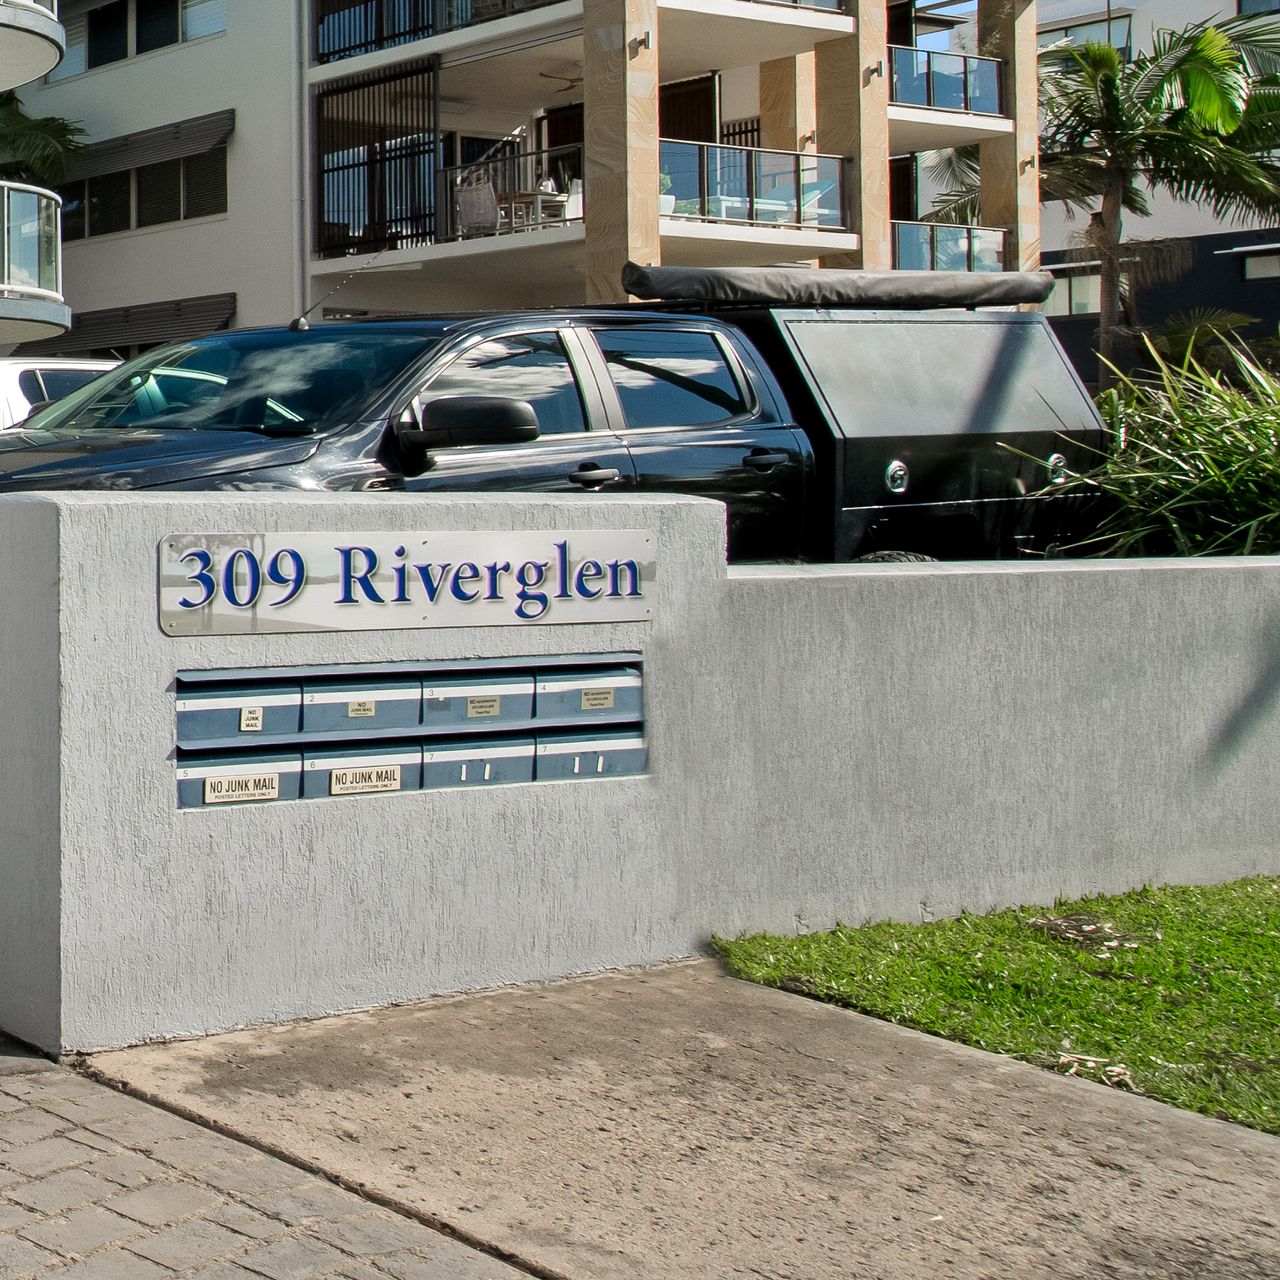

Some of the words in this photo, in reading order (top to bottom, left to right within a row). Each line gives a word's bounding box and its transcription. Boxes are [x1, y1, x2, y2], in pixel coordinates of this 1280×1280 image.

[177, 547, 306, 609] 309
[333, 539, 643, 619] Riverglen
[209, 780, 223, 794] NO
[225, 779, 250, 793] JUNK
[252, 777, 276, 791] MAIL
[335, 772, 347, 786] NO
[349, 771, 373, 785] JUNK
[375, 769, 397, 782] MAIL
